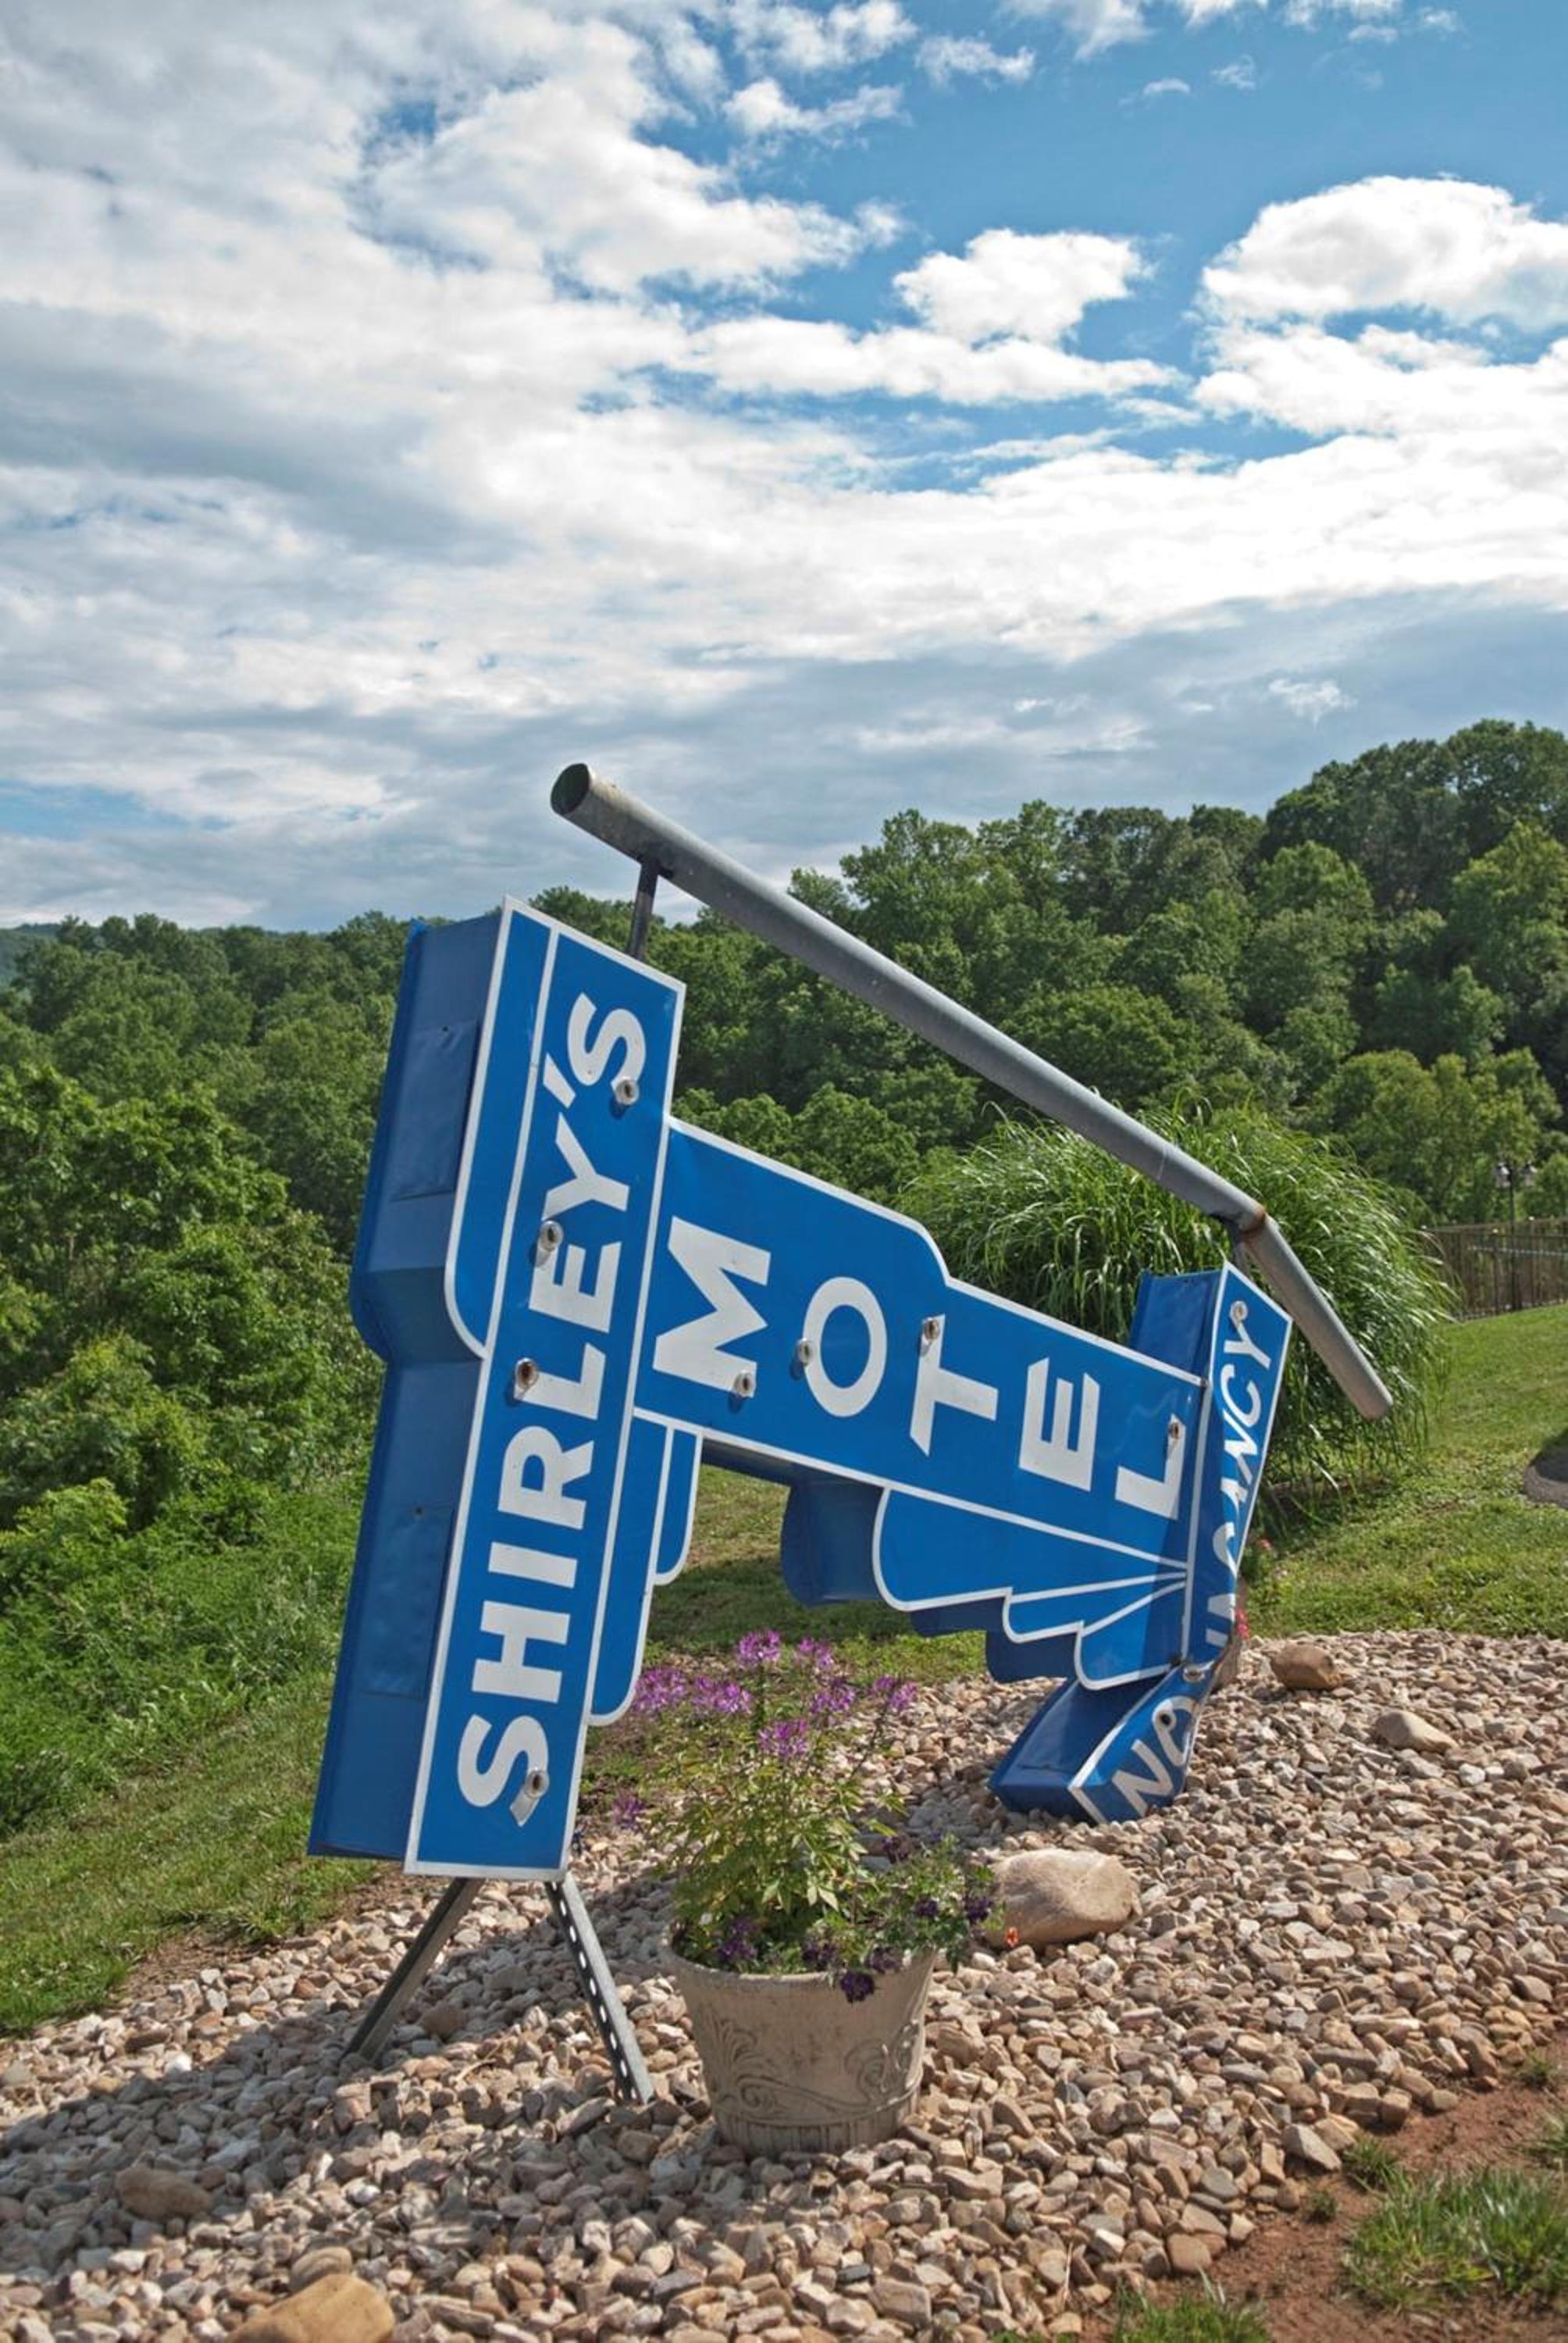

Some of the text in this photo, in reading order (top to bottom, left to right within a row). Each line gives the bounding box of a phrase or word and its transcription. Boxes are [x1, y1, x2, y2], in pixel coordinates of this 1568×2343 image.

[457, 992, 647, 1826] SHIRLEY'S
[653, 1216, 1187, 1520] MOTEL
[1112, 1695, 1201, 1817] NO
